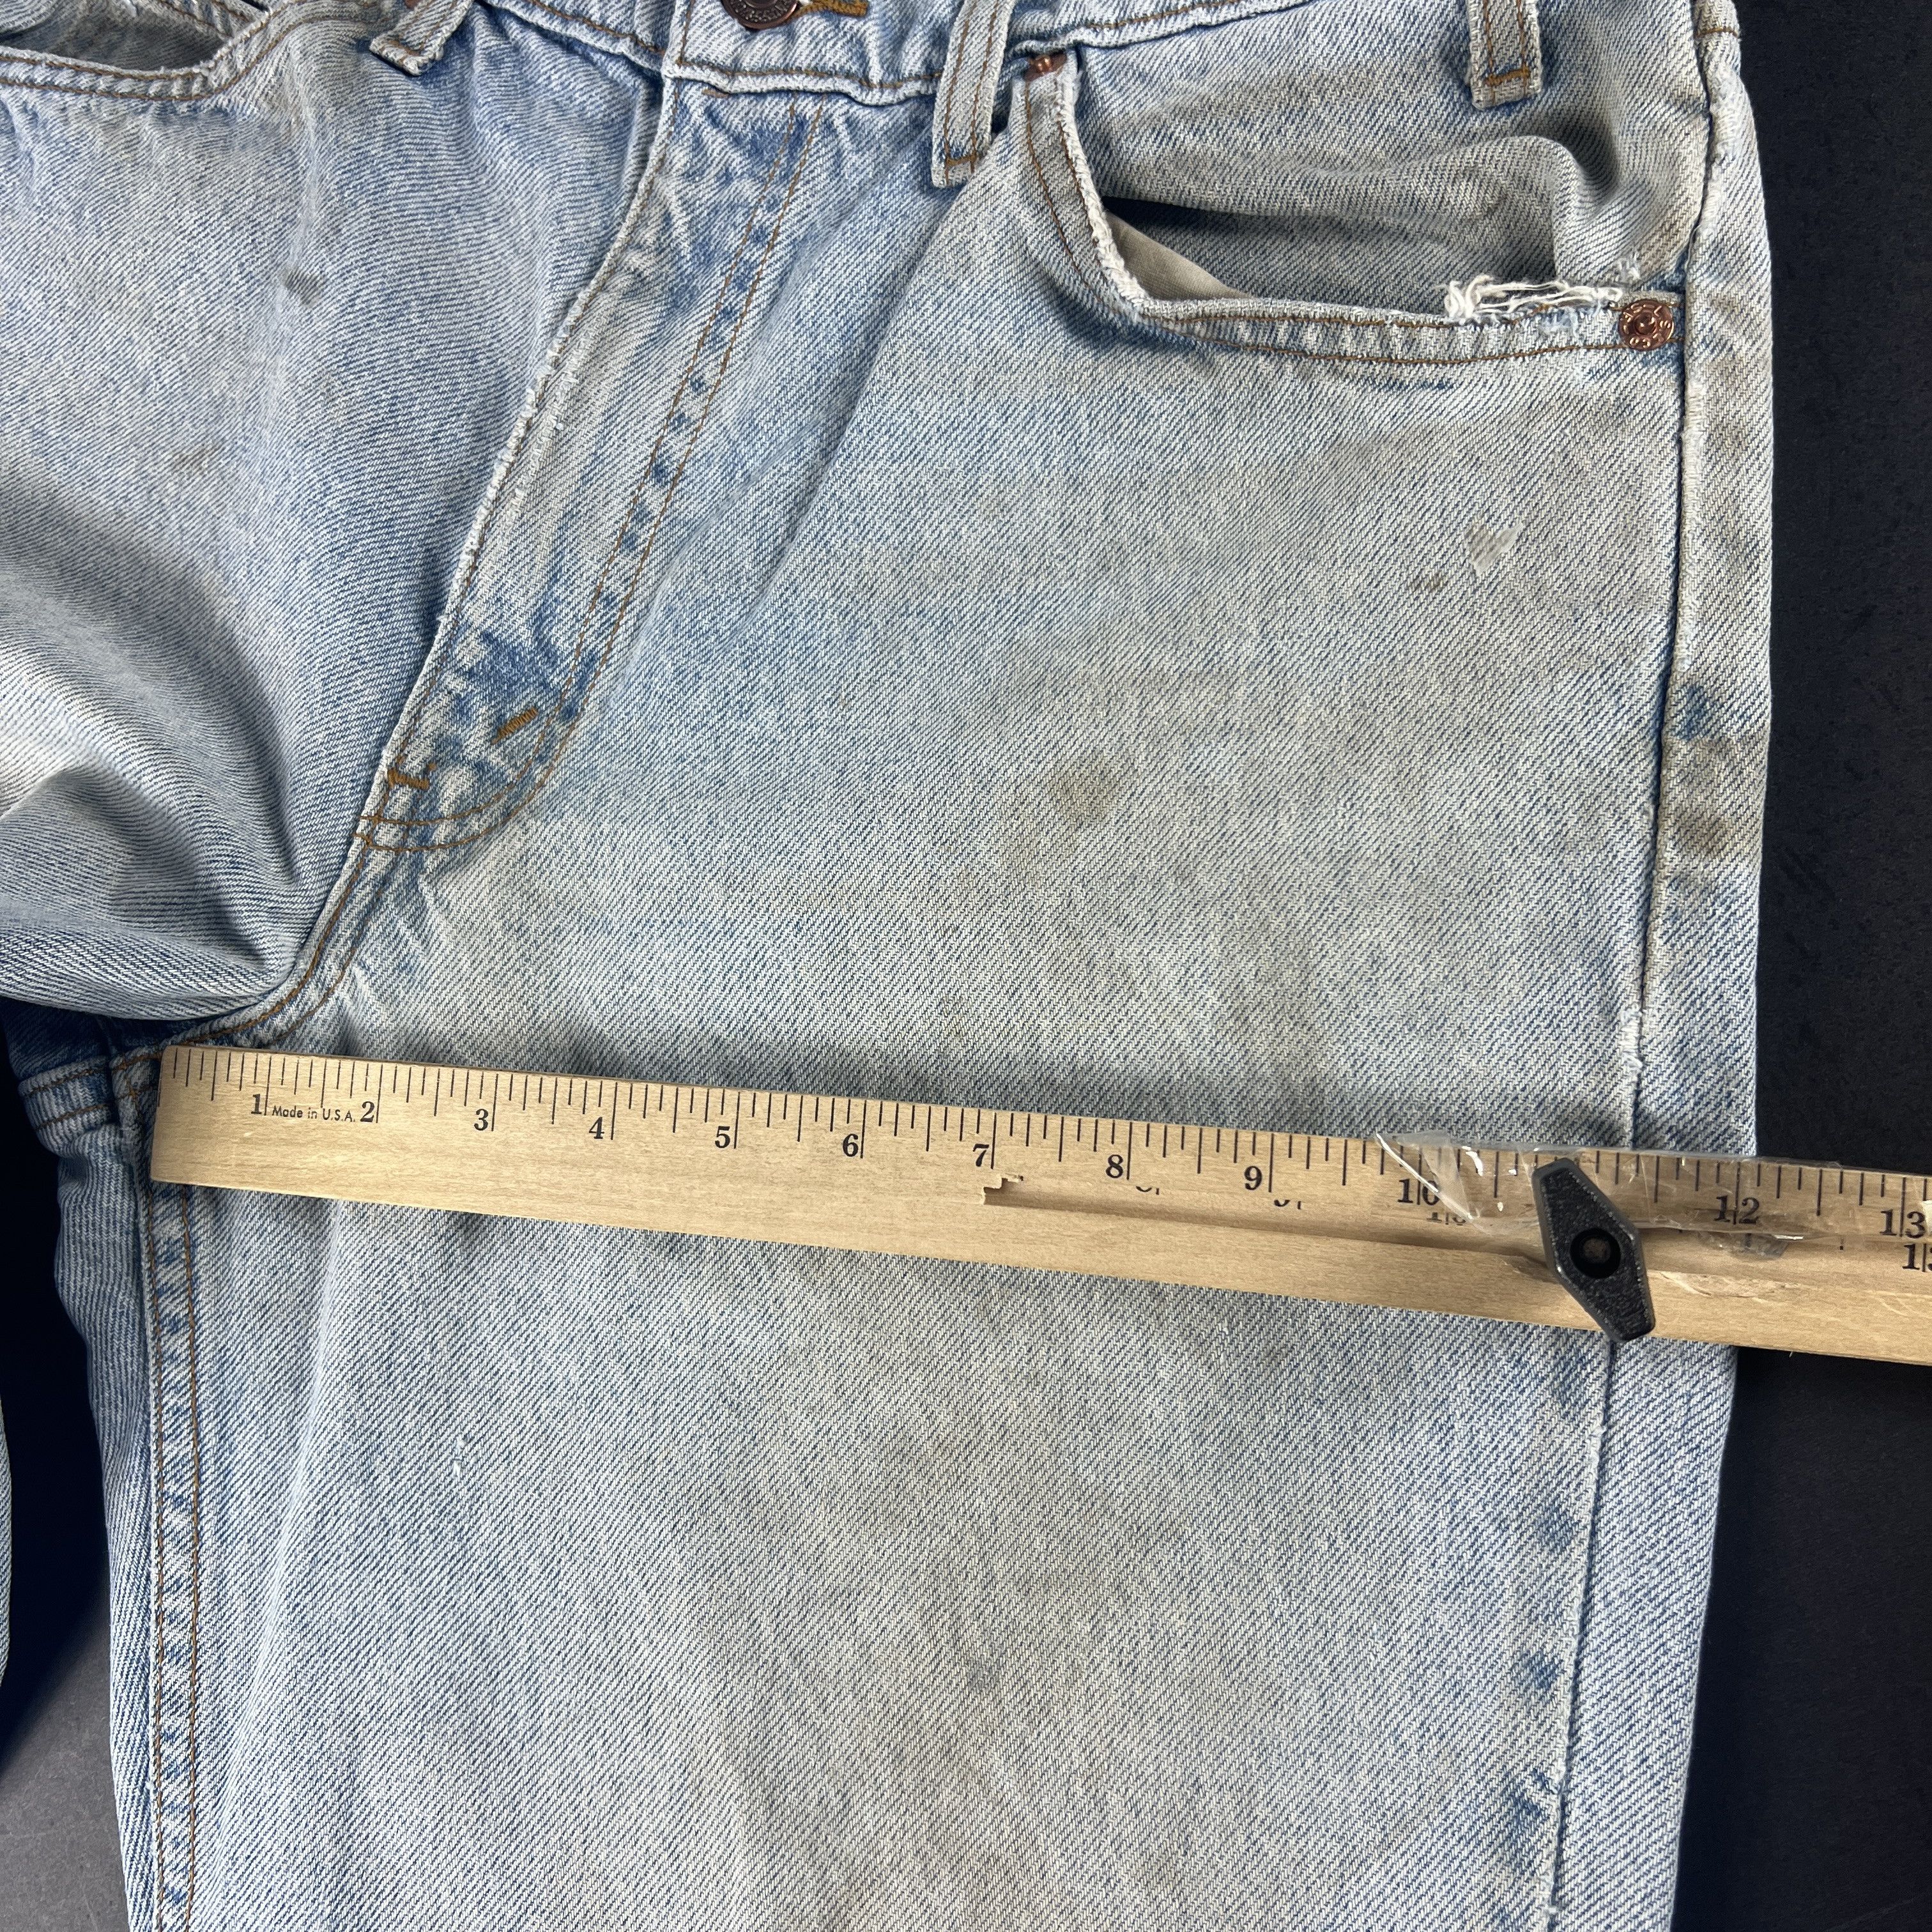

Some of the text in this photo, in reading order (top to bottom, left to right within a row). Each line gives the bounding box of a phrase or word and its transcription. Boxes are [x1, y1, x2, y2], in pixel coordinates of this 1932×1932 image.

[250, 1093, 263, 1115] 1
[272, 1104, 356, 1123] Made in U.S.A.
[359, 1101, 376, 1123] 2
[473, 1108, 489, 1131] 3
[588, 1116, 605, 1139] 4
[714, 1125, 731, 1149] 5
[842, 1133, 859, 1157] 6
[972, 1143, 990, 1167] 7
[1105, 1154, 1124, 1179] 8
[1244, 1165, 1263, 1191] 9
[1397, 1178, 1441, 1206] 10
[1713, 1195, 1759, 1225] 12
[1880, 1208, 1926, 1239] 13
